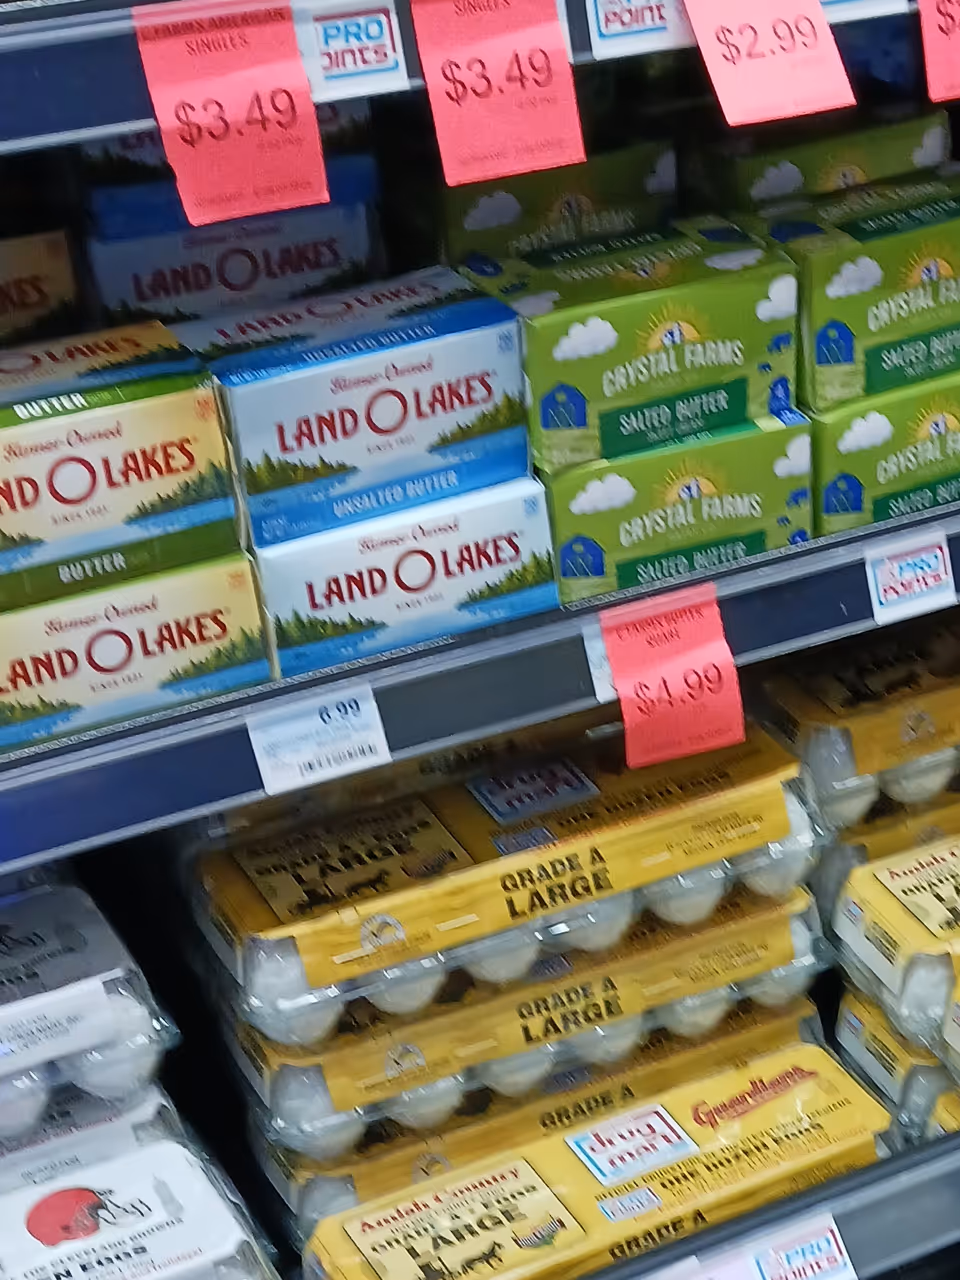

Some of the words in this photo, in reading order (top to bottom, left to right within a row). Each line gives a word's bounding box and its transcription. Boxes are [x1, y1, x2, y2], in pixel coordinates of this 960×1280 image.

[322, 17, 384, 46] PRO
[604, 4, 667, 29] POINT
[713, 14, 819, 65] $2.99
[321, 44, 388, 71] OINTS
[440, 48, 553, 107] $3.49
[175, 88, 298, 148] $3.49
[133, 263, 211, 300] LAND
[216, 248, 261, 291] O
[261, 237, 341, 277] LAKES
[867, 284, 936, 332] CRYSTAL
[603, 347, 681, 398] CRYSTAL
[685, 340, 744, 369] FARMS
[13, 392, 89, 420] BUTTER
[275, 408, 359, 454] LAND
[365, 388, 409, 436] O
[413, 372, 494, 419] LAKES
[619, 405, 671, 435] SALTED
[675, 389, 728, 419] BUTTER
[46, 456, 97, 505] O
[102, 437, 196, 489] LAKES
[877, 437, 944, 485] CRYSTAL
[333, 486, 405, 520] UNSALTED
[406, 469, 459, 498] BUTTER
[619, 503, 696, 547] CRYSTAL
[702, 493, 763, 520] FARMS
[58, 552, 127, 583] BUTTER
[305, 567, 388, 612] LAND
[394, 549, 436, 595] O
[440, 531, 521, 579] LAKES
[85, 629, 133, 673] O
[136, 608, 228, 657] LAKES
[634, 662, 725, 718] $4.99
[500, 852, 584, 893] GRADE
[589, 846, 607, 866] A
[504, 867, 613, 920] LARGE
[516, 981, 593, 1021] GRADE
[601, 975, 619, 993] A
[521, 994, 624, 1045] LARGE
[360, 1199, 431, 1234] Amish
[433, 1168, 521, 1204] Country
[402, 1204, 529, 1260] LARGE
